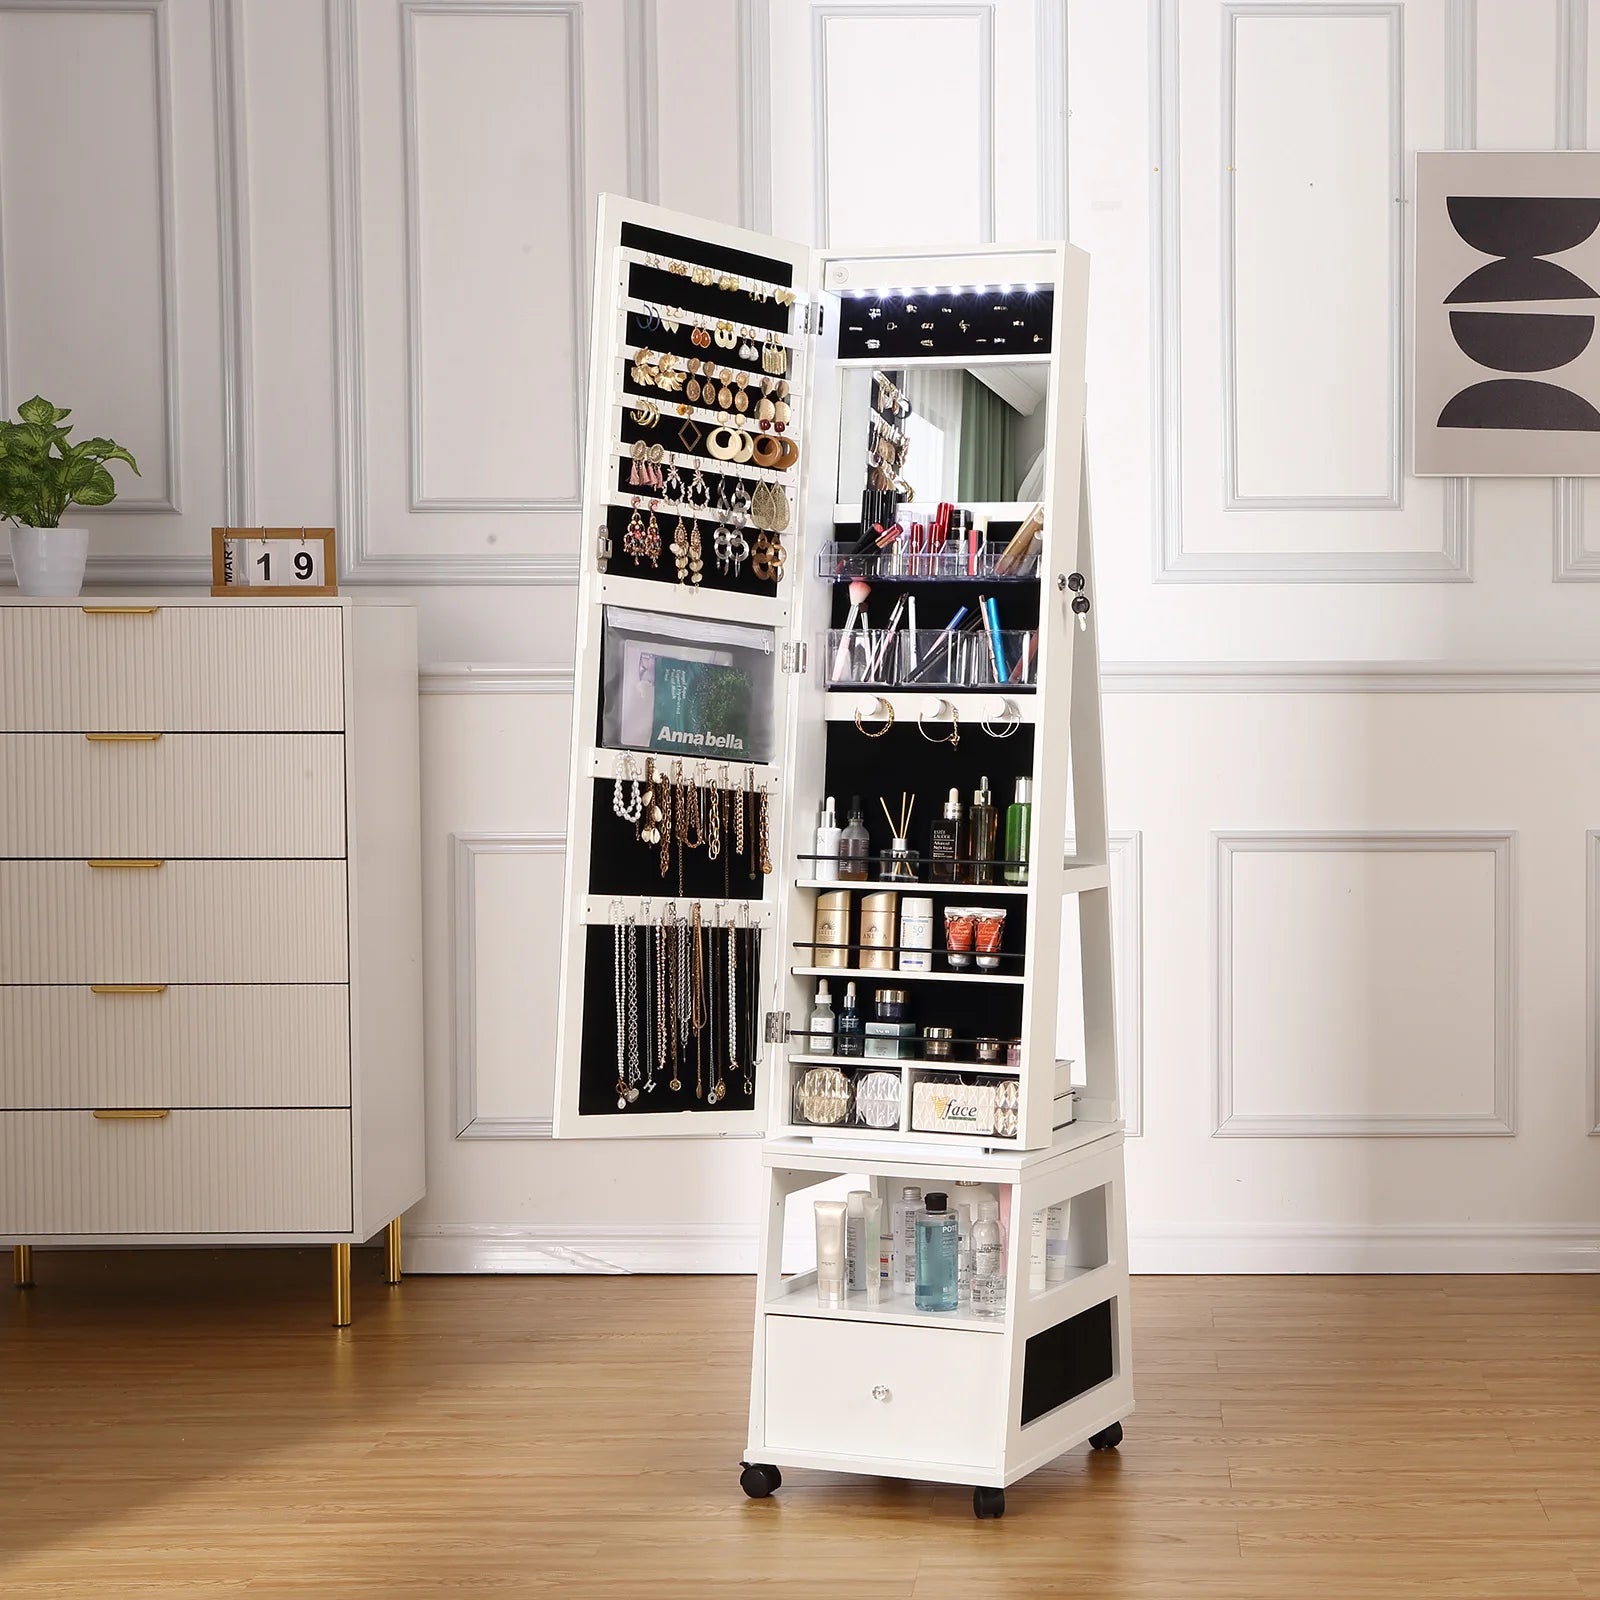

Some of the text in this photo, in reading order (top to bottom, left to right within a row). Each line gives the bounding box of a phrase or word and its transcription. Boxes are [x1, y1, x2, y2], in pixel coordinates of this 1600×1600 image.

[256, 551, 314, 581] 1 9
[657, 725, 744, 751] Annabella
